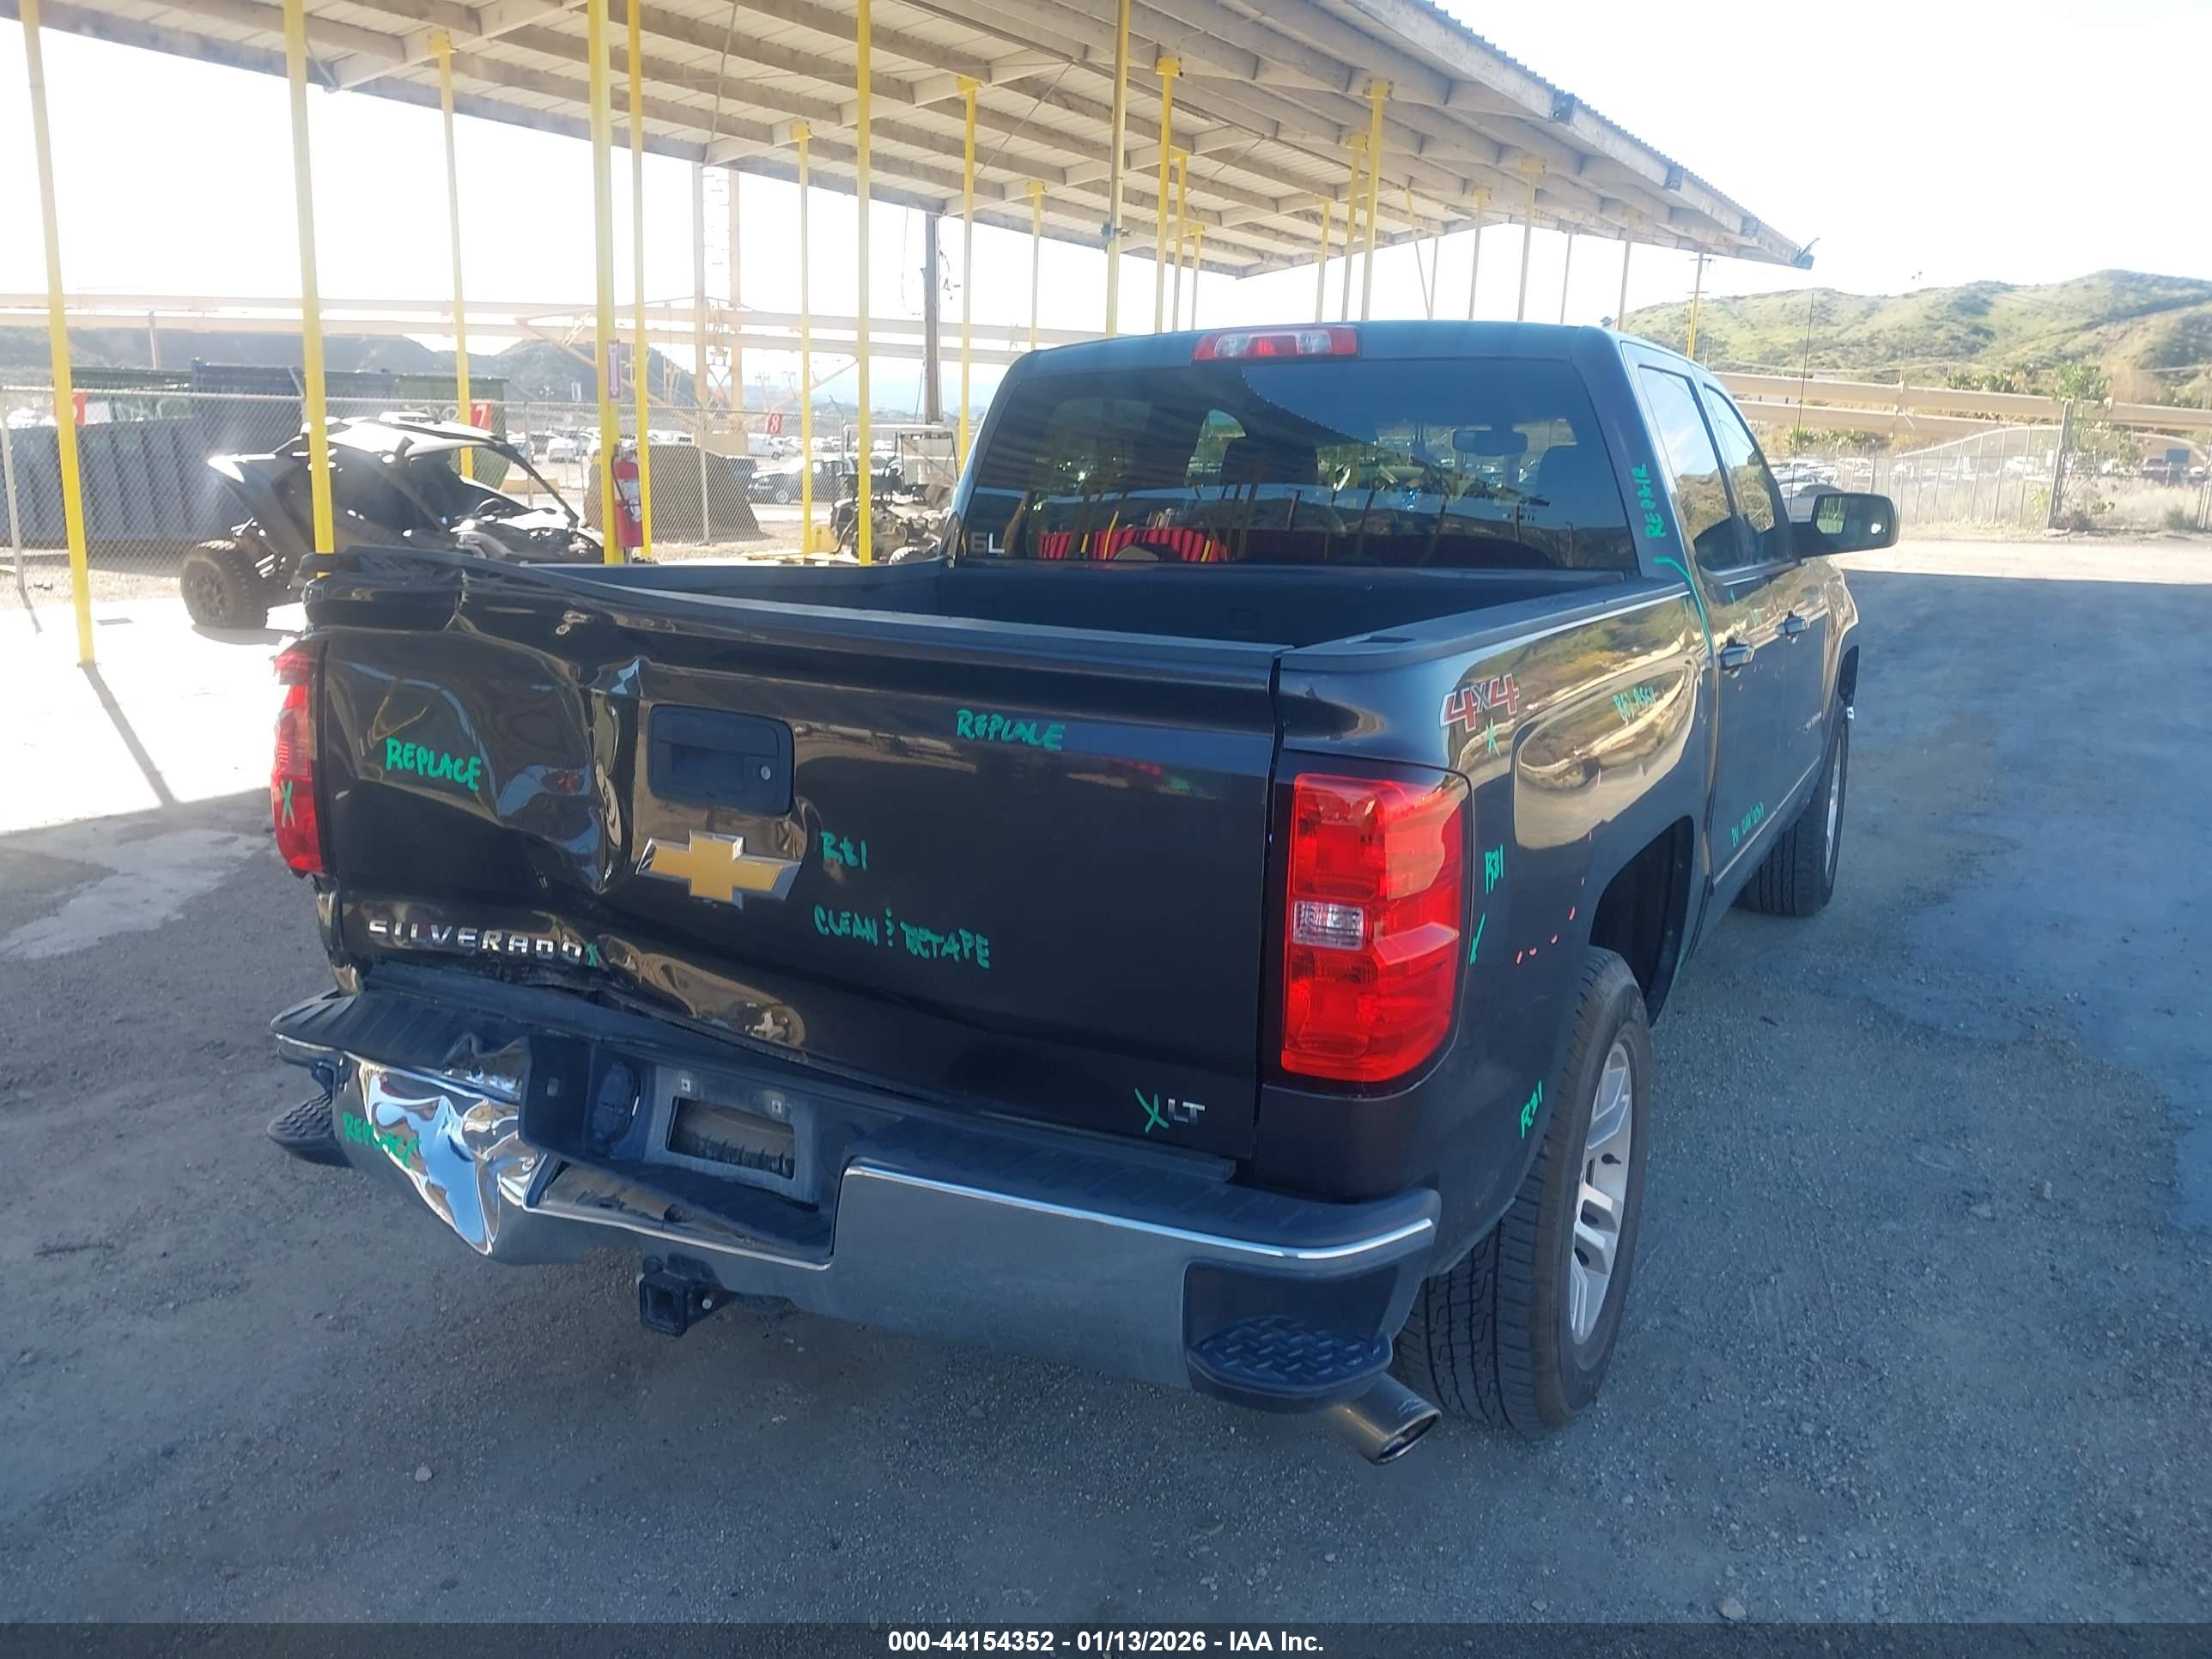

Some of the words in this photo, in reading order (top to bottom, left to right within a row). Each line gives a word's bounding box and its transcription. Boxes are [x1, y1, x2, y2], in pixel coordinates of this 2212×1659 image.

[475, 404, 488, 428] 7
[769, 413, 781, 433] 8
[386, 737, 482, 792] REPLACE
[368, 918, 584, 963] SILVERADO
[814, 904, 878, 947] CLEAN
